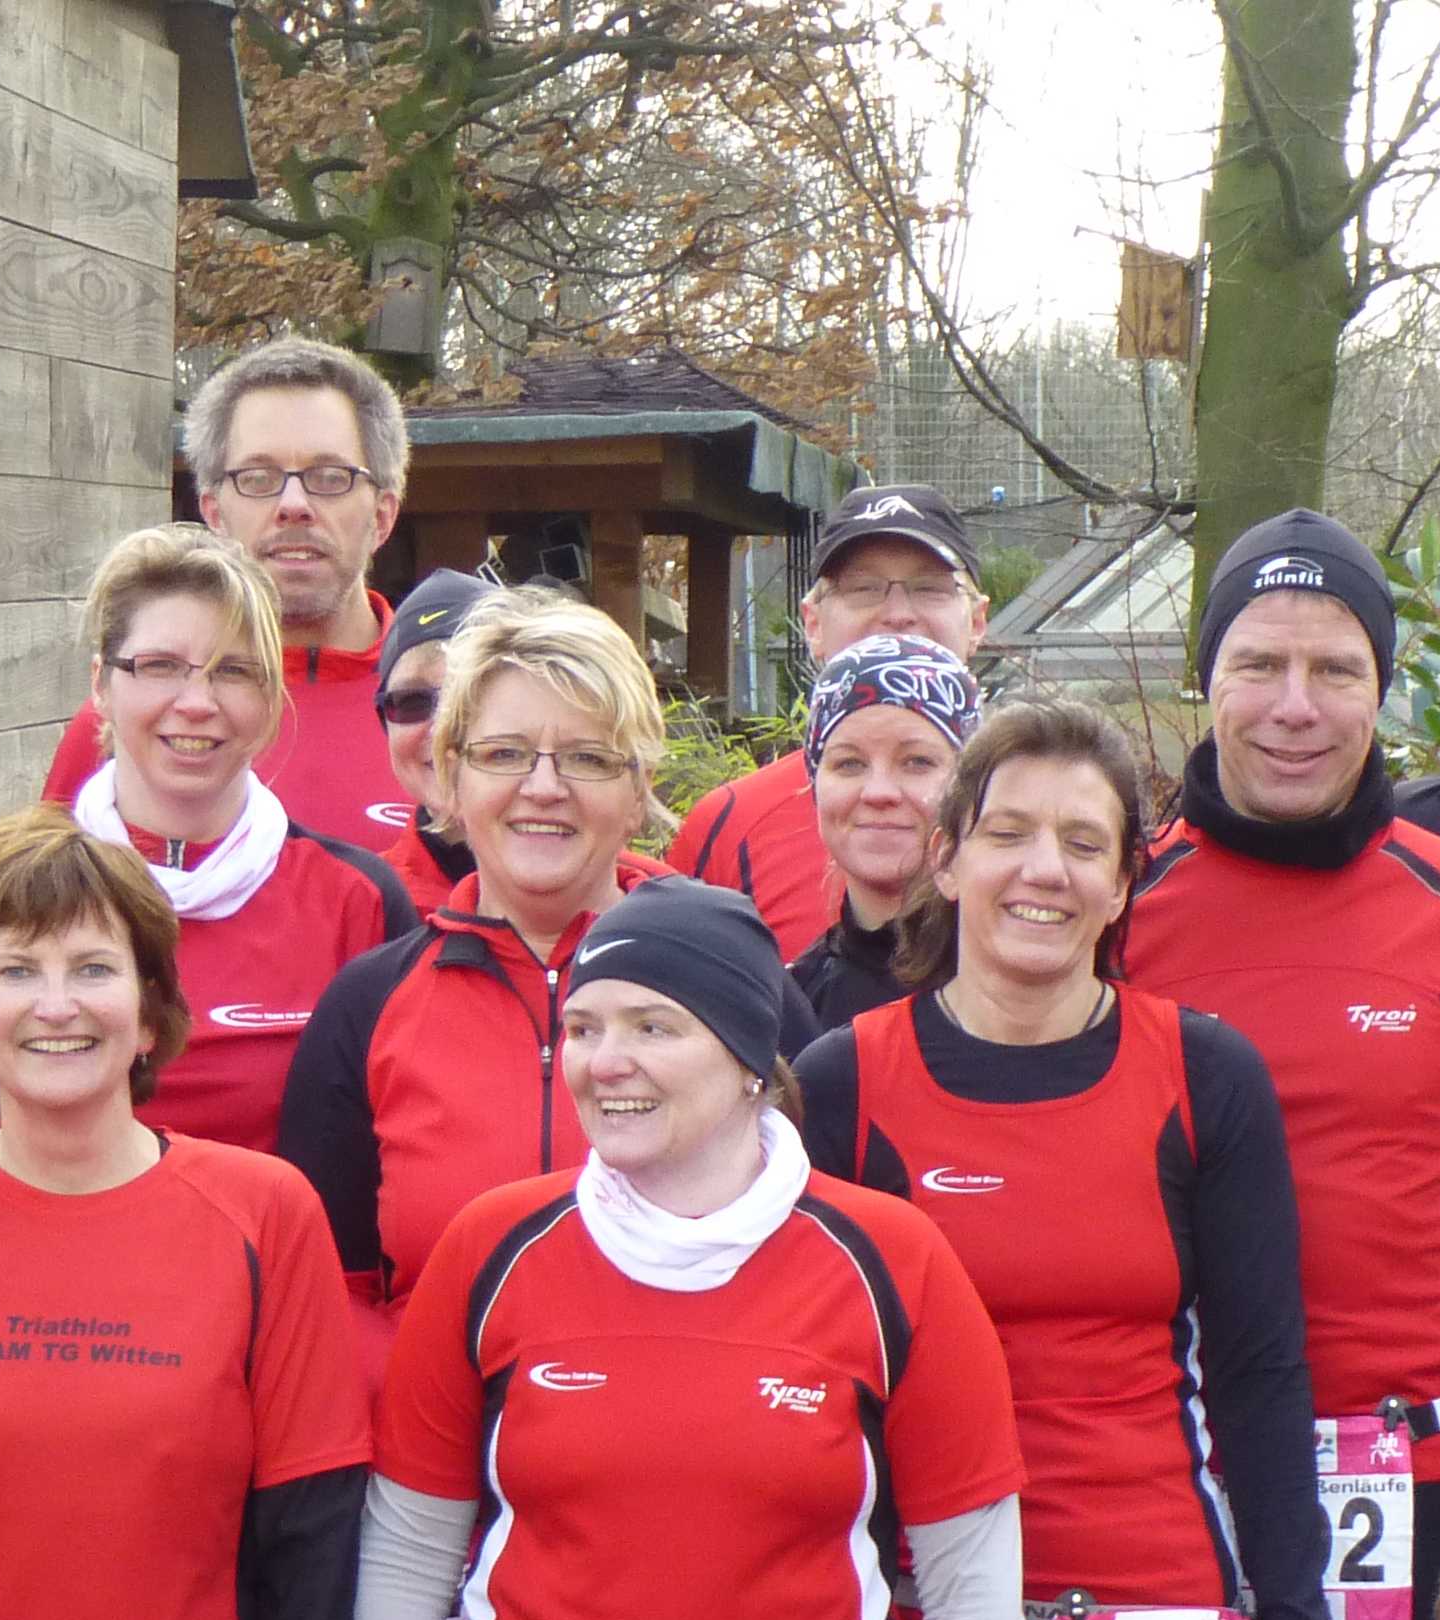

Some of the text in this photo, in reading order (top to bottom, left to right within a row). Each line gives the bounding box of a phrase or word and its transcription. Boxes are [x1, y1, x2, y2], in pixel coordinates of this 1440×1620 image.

[1253, 571, 1324, 588] skinfit
[1346, 1005, 1417, 1033] Tyron
[8, 1316, 131, 1336] Triathlon
[43, 1342, 79, 1361] TG
[90, 1344, 182, 1367] Witten
[758, 1377, 827, 1409] Tyron
